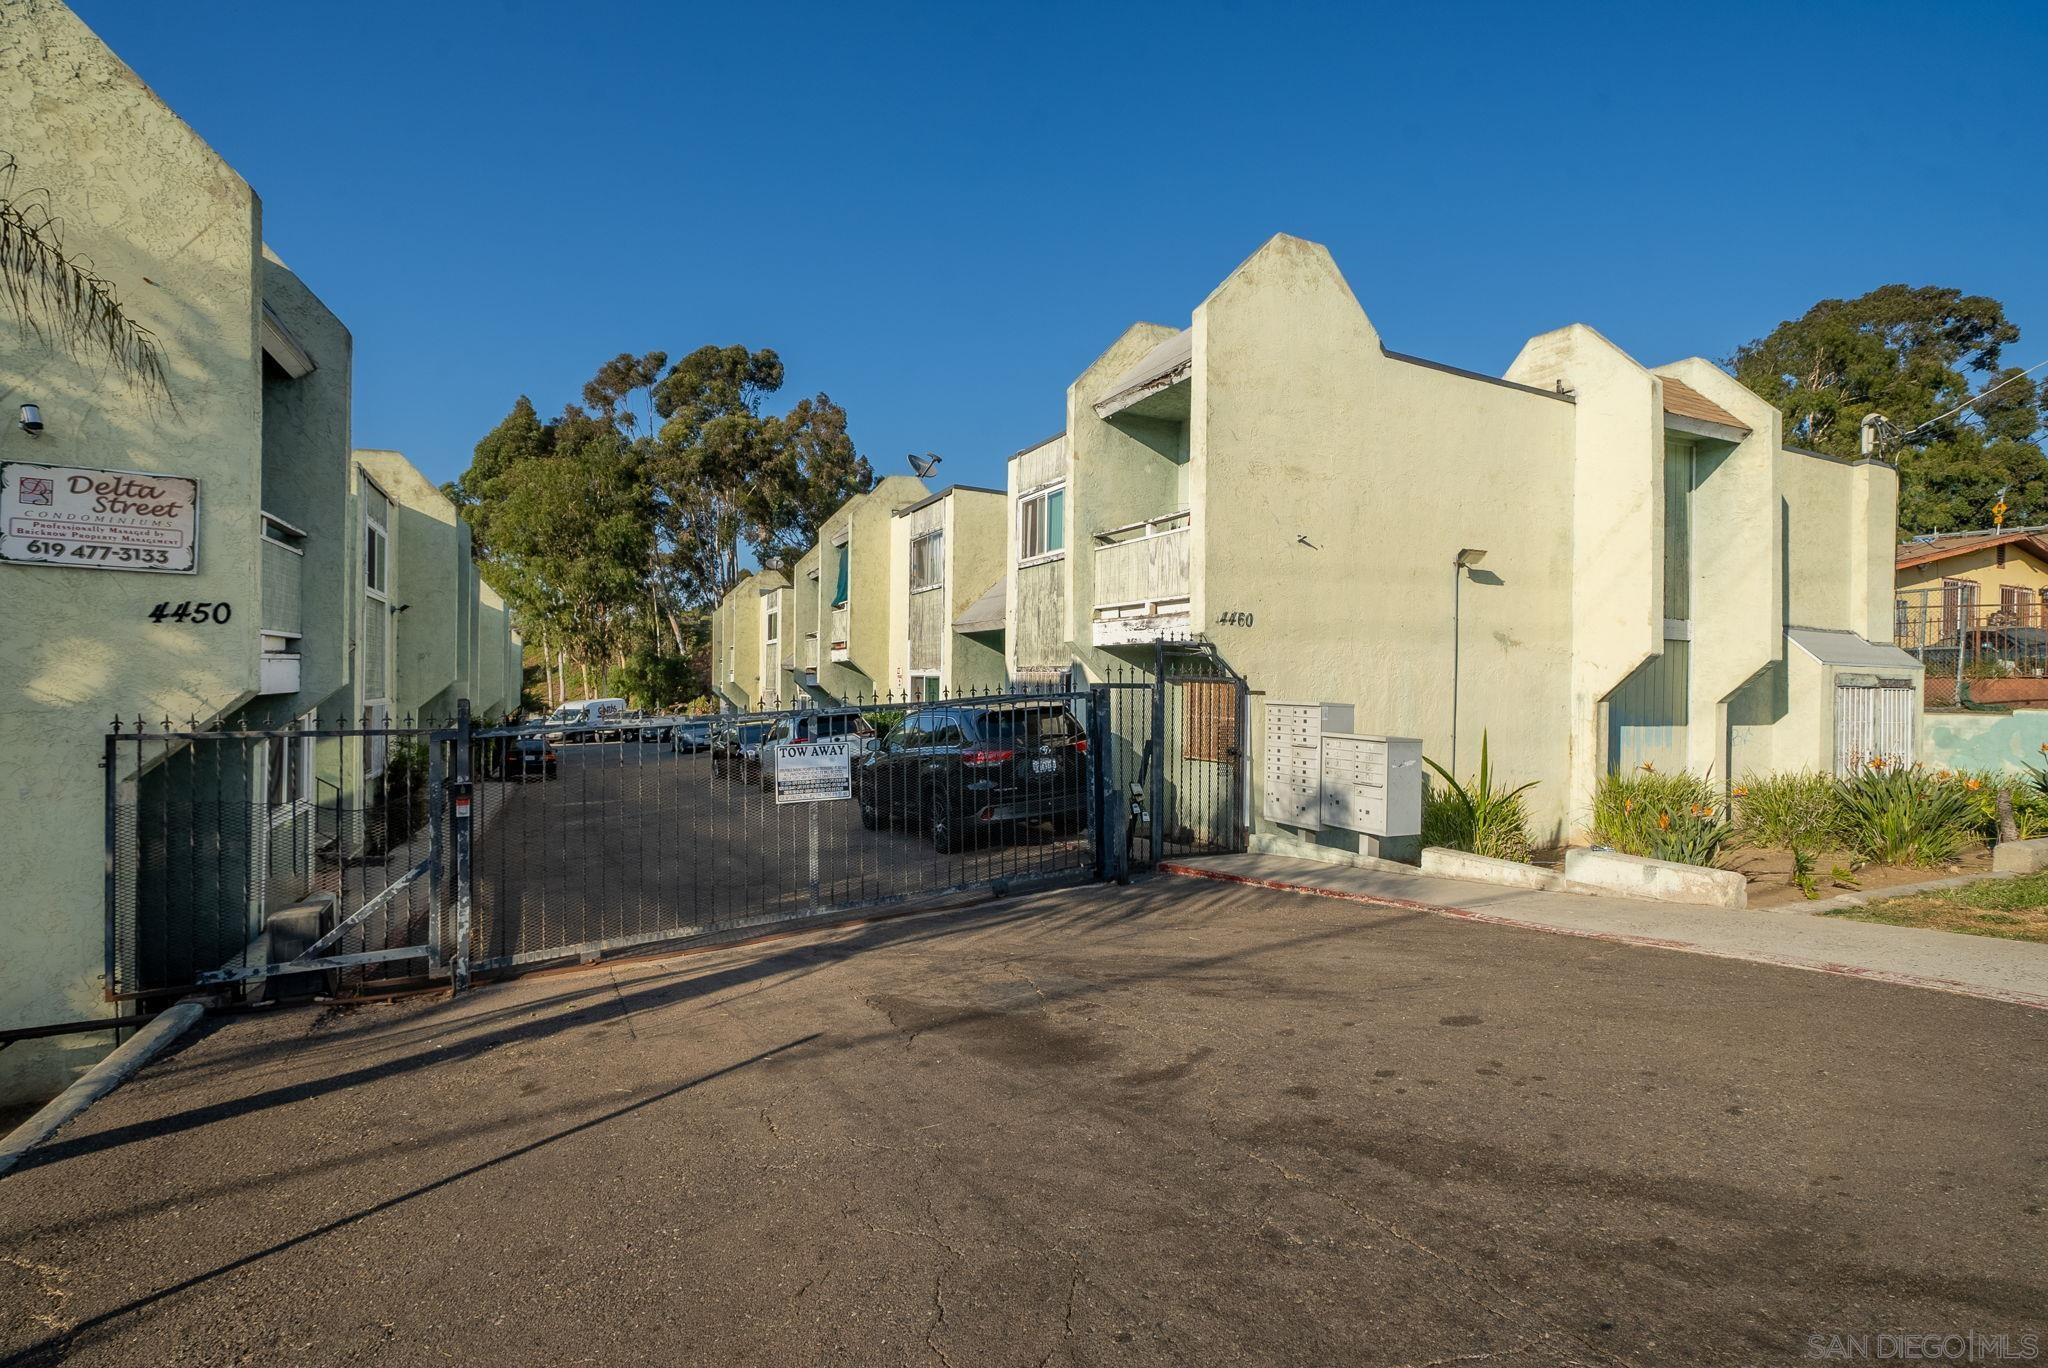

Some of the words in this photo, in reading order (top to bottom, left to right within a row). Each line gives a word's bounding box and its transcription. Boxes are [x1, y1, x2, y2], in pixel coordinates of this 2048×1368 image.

[67, 475, 166, 500] Delta
[92, 496, 183, 518] Street
[24, 510, 173, 528] CONDOMINIUMS
[27, 540, 66, 557] 619
[70, 545, 169, 564] 477-3133
[148, 601, 231, 624] 4450
[1216, 611, 1253, 627] 4460
[779, 747, 808, 758] TOW
[811, 745, 845, 757] AWAY
